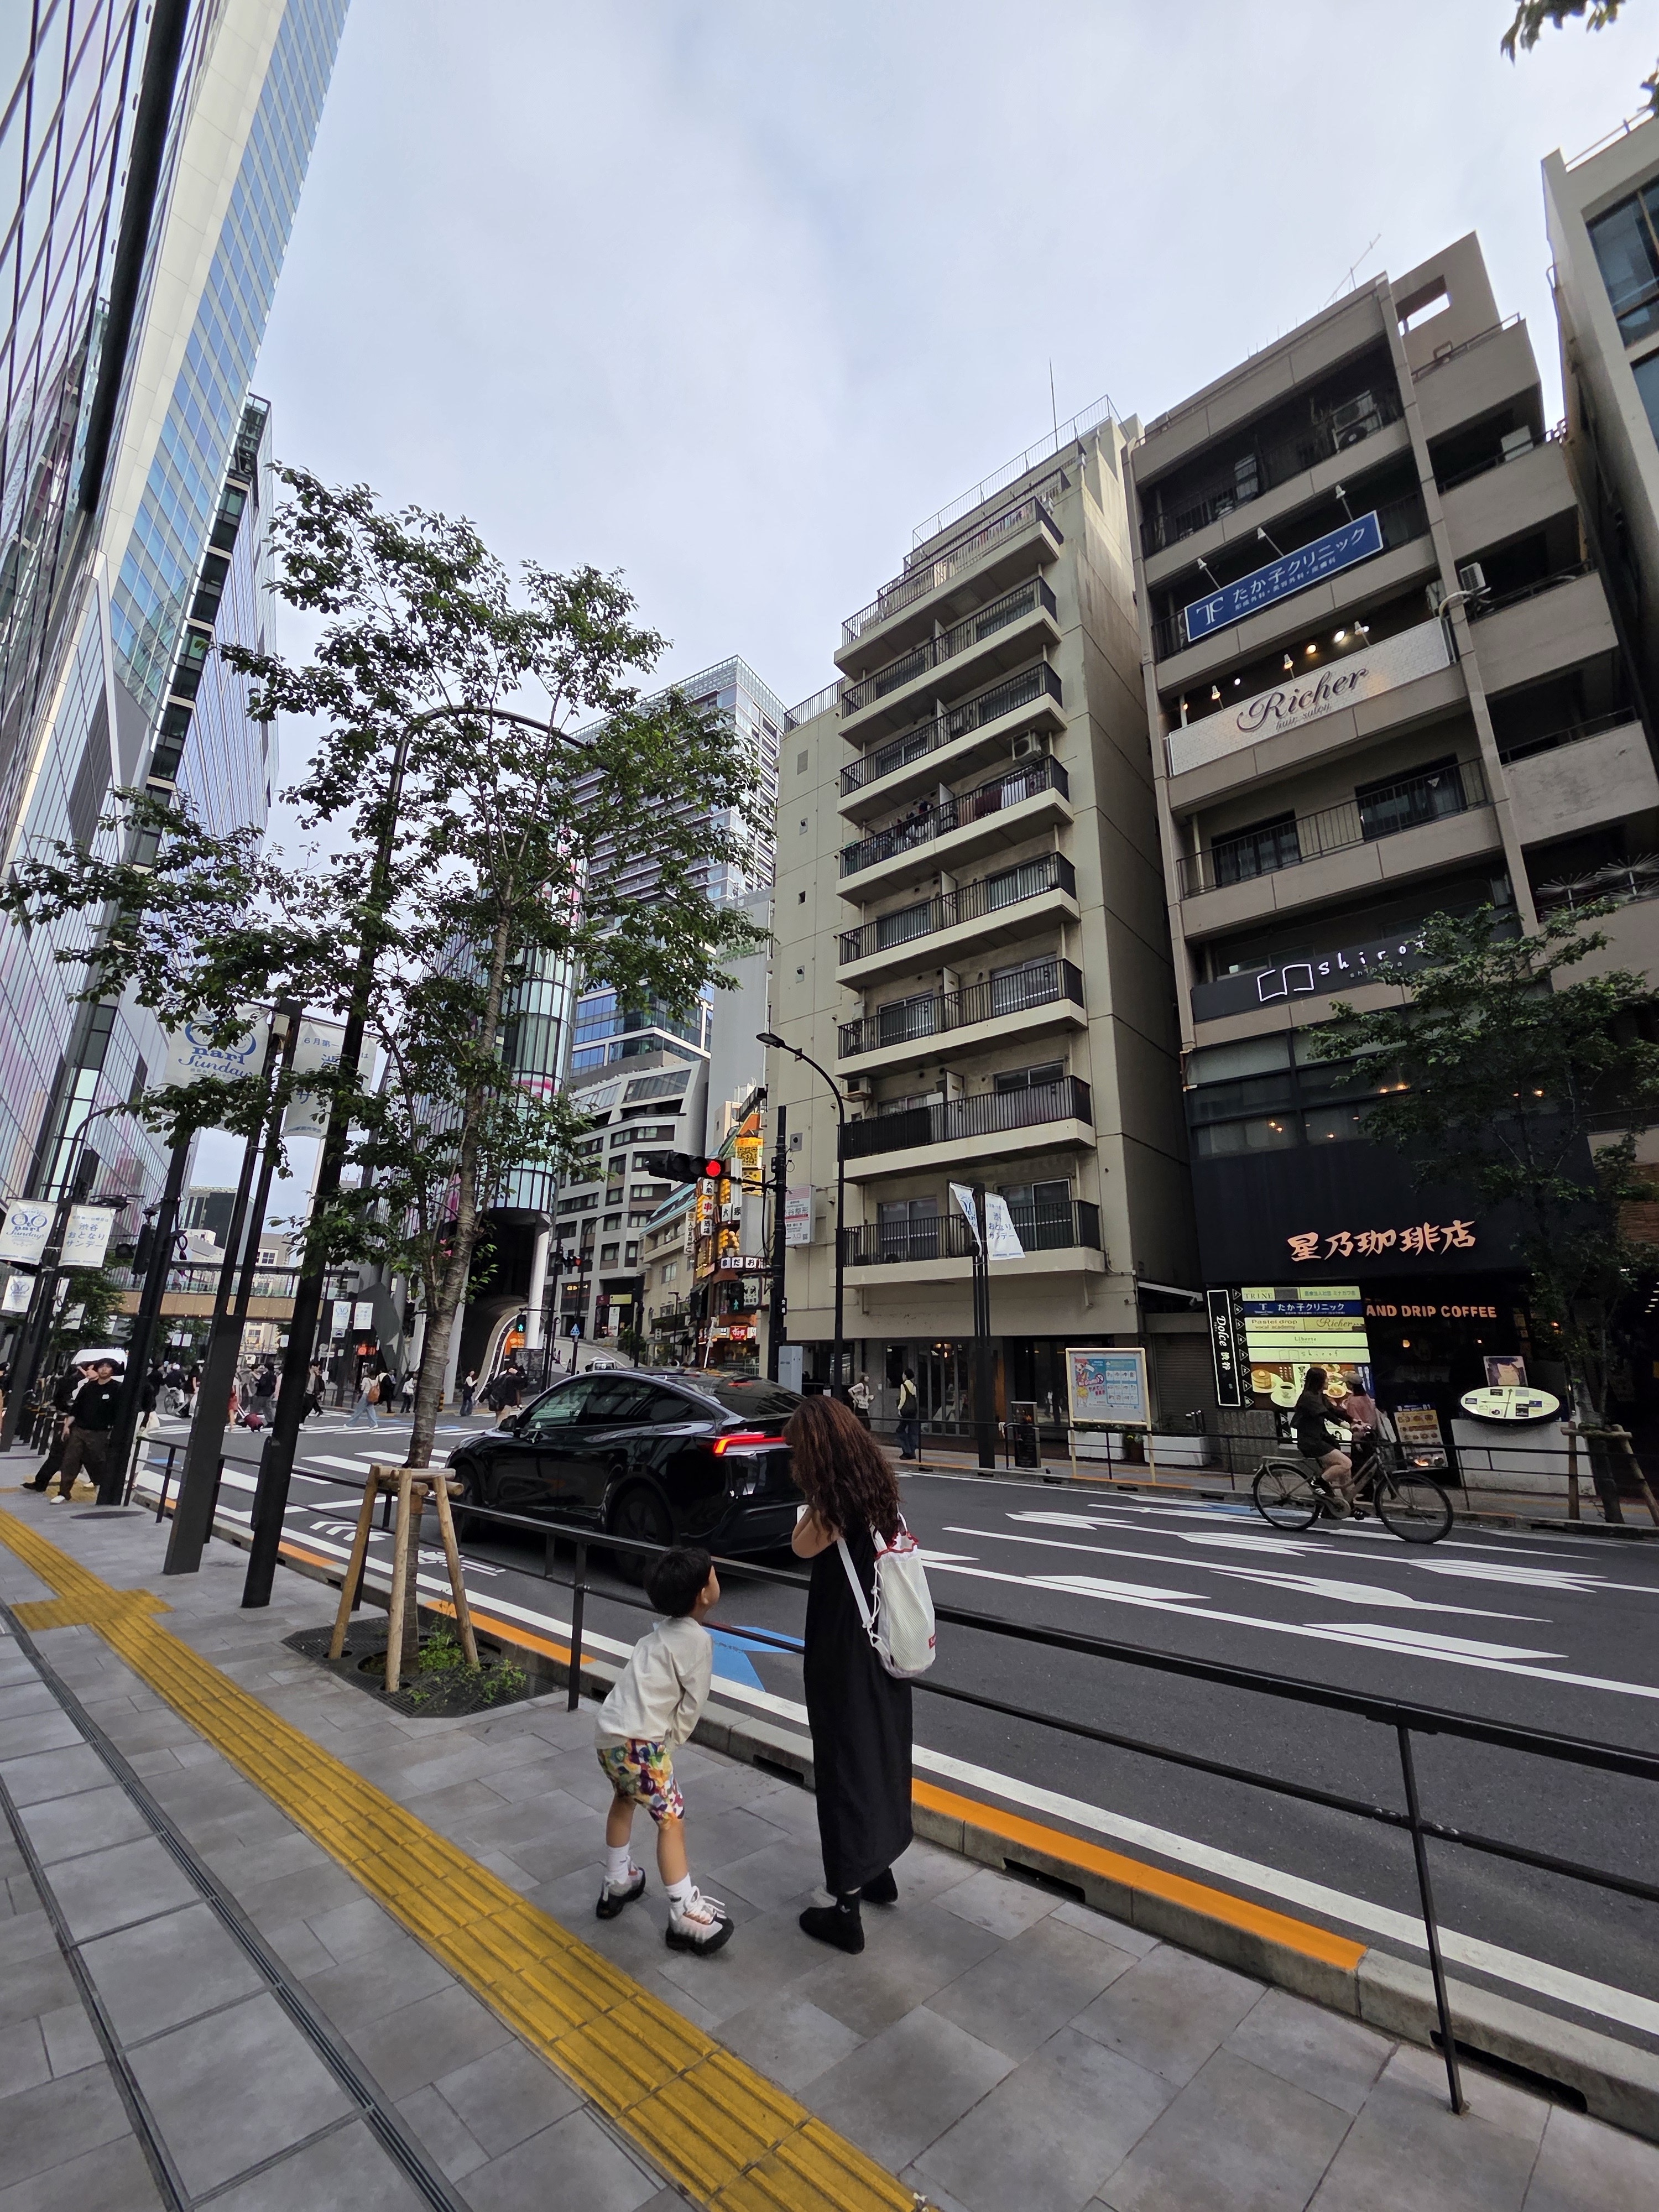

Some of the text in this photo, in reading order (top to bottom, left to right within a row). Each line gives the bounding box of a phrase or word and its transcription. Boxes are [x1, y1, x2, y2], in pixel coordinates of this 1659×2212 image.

[1233, 528, 1365, 604] たか子クリニック
[1237, 668, 1370, 733] Richer
[192, 1046, 245, 1065] nari
[67, 1231, 105, 1241] おとなり
[1287, 1219, 1477, 1262] 星乃珈琲店
[1278, 1303, 1345, 1312] たか子クリニック
[1401, 1305, 1437, 1317] DRIP
[1441, 1306, 1497, 1318] COFFEE
[1217, 1316, 1229, 1347] Dolce
[1316, 1318, 1353, 1328] Richer
